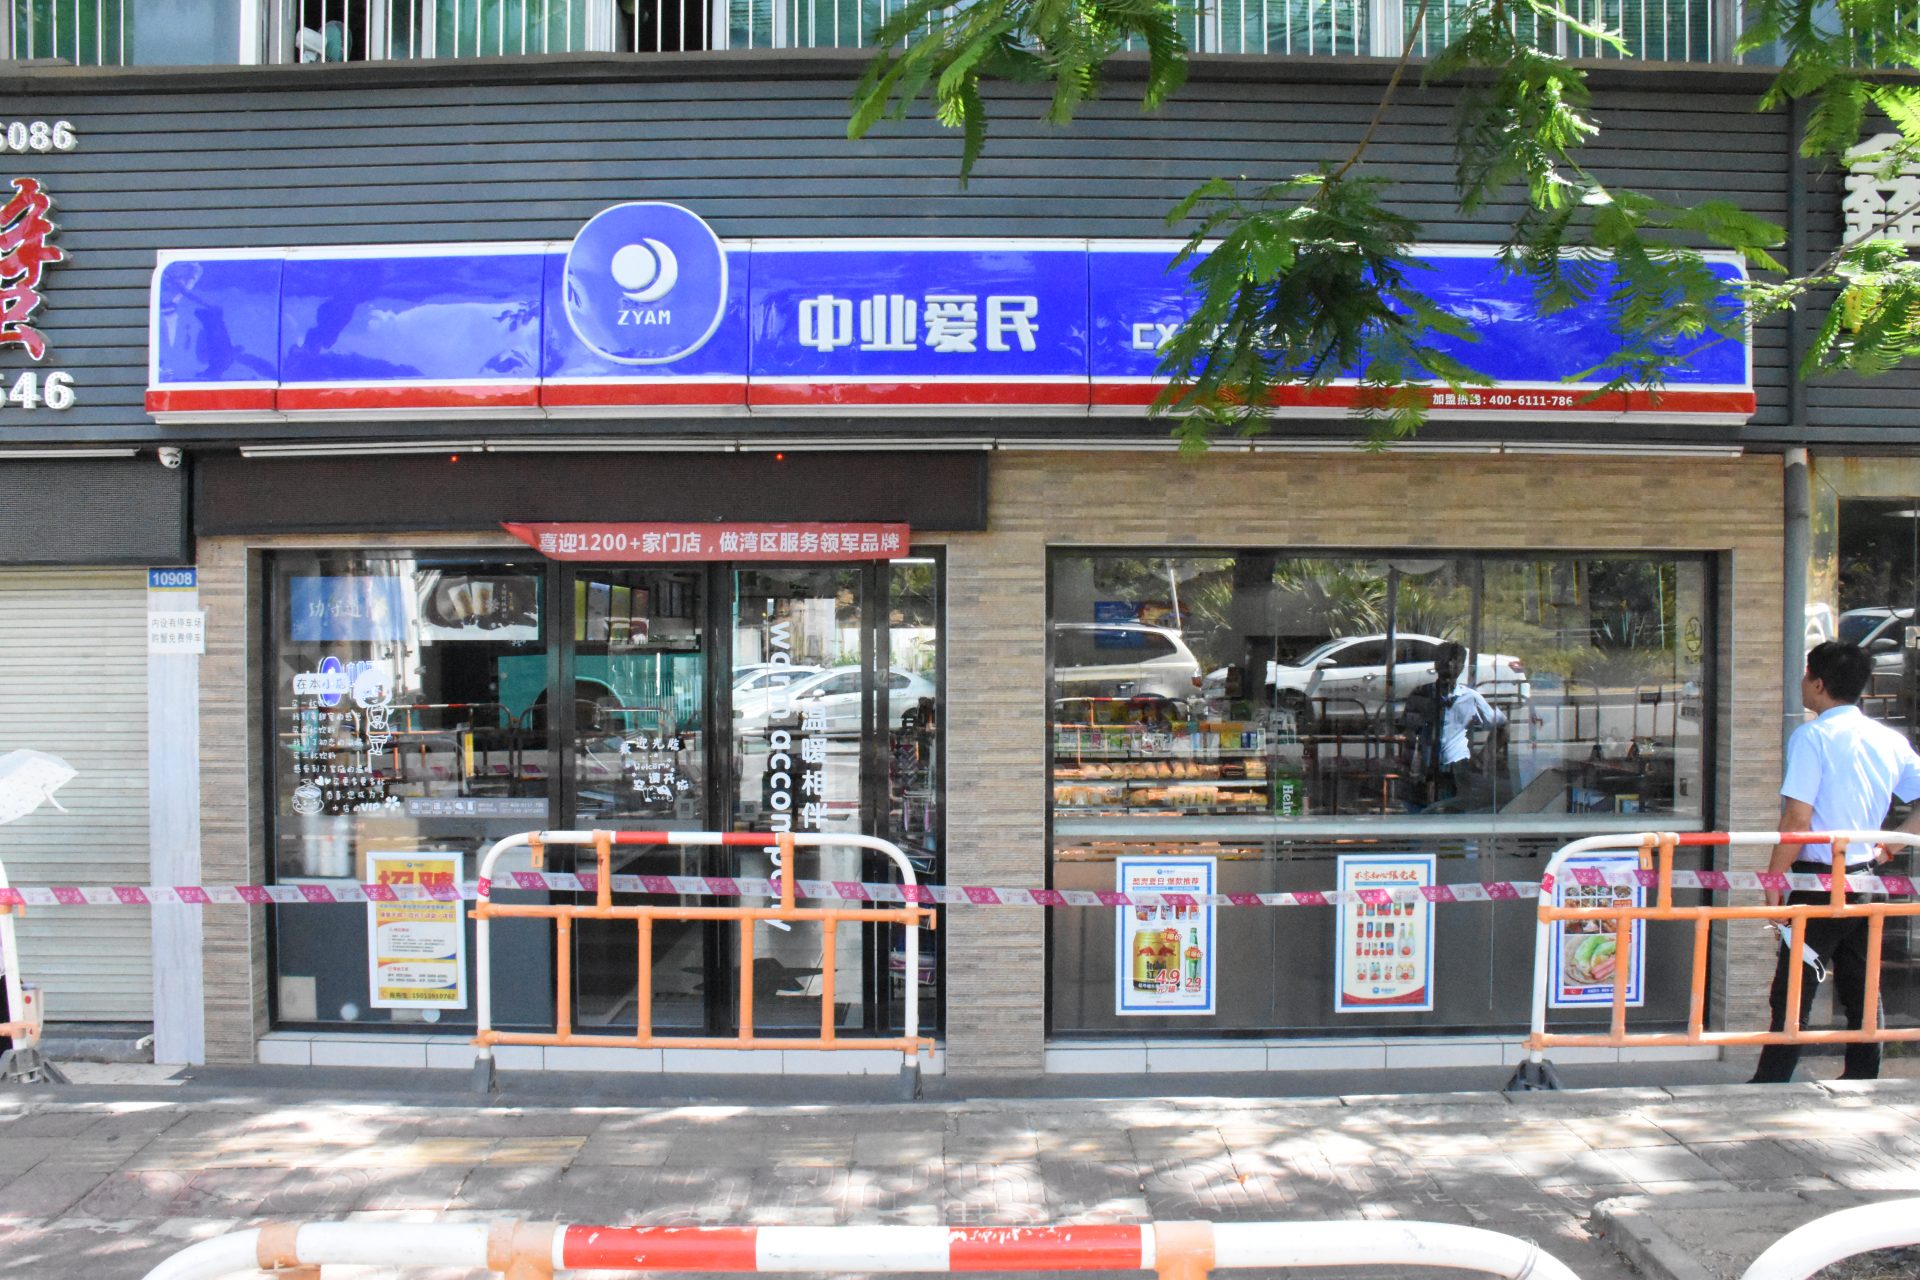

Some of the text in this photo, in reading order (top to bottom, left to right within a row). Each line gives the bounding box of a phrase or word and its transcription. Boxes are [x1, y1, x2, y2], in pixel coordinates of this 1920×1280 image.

[617, 309, 672, 326] ZYAM
[798, 293, 1040, 353] 中业爱民
[152, 572, 192, 586] 10908
[801, 705, 828, 829] 温暖相伴
[1155, 969, 1181, 985] 4.9
